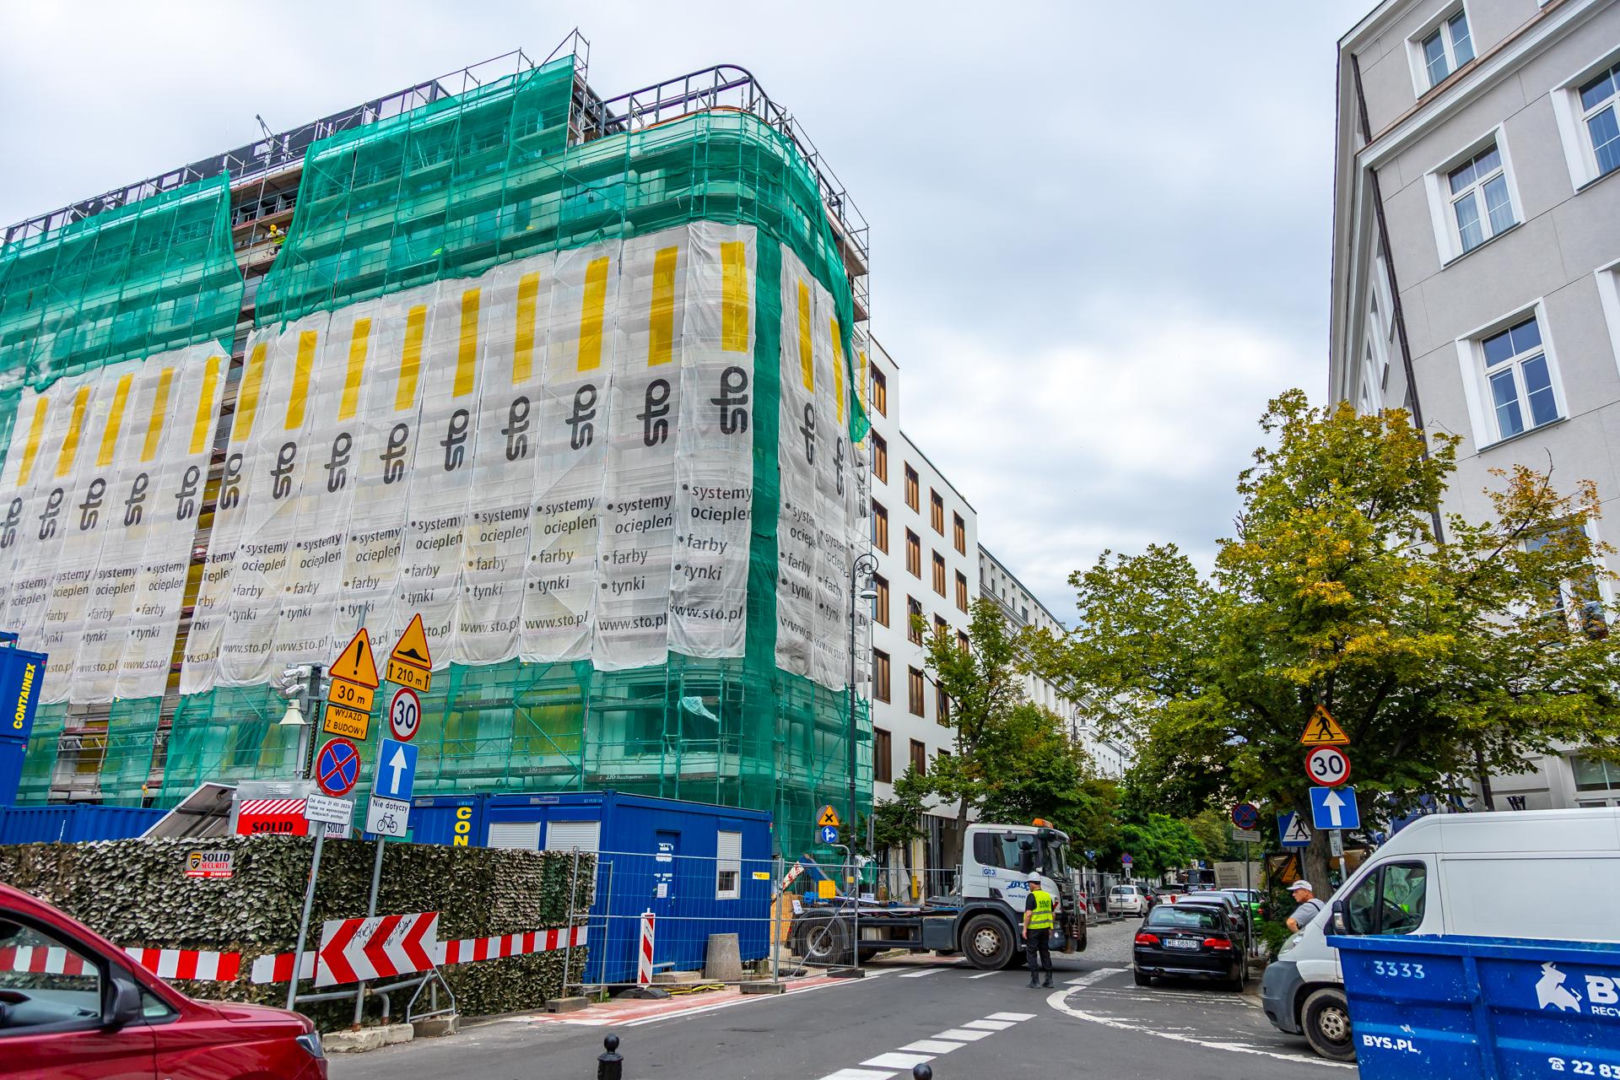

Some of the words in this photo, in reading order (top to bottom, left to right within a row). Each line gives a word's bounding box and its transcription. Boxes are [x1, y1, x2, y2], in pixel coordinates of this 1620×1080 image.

[711, 366, 748, 435] sto
[565, 384, 597, 450] sto
[636, 379, 670, 447] sto
[501, 396, 530, 461] sto
[799, 402, 815, 466] sto
[440, 409, 470, 471] sto
[324, 432, 352, 493] sto
[380, 423, 409, 484] sto
[270, 442, 296, 499] sto
[833, 437, 845, 498] sto
[220, 453, 243, 510] sto
[124, 472, 149, 527] sto
[175, 465, 200, 520] sto
[692, 484, 753, 501] systemy
[79, 478, 106, 530] sto
[545, 496, 595, 517] systemy
[617, 495, 672, 515] systemy
[1, 497, 22, 548] sto
[39, 488, 63, 540] sto
[482, 505, 529, 524] systemy
[615, 513, 673, 534] ociepleń
[418, 516, 462, 533] systemy
[544, 514, 597, 535] ociepleń
[304, 533, 342, 550] systemy
[359, 526, 402, 544] systemy
[416, 531, 463, 551] ociepleń
[687, 533, 728, 555] farby
[246, 540, 289, 556] systemy
[356, 542, 401, 563] ociepleń
[539, 548, 574, 564] farby
[613, 548, 648, 565] farby
[242, 555, 286, 576] ociepleń
[300, 549, 341, 569] ociepleń
[476, 556, 507, 572] farby
[788, 553, 811, 577] farby
[98, 566, 137, 582] systemy
[152, 561, 187, 577] systemy
[411, 564, 440, 579] farby
[684, 565, 723, 582] tynki
[236, 585, 264, 599] farby
[293, 580, 320, 595] farby
[351, 575, 380, 590] farby
[473, 582, 503, 600] tynki
[537, 575, 570, 594] tynki
[611, 576, 645, 595] tynki
[791, 581, 813, 601] tynki
[408, 588, 434, 606] tynki
[141, 604, 166, 618] farby
[232, 607, 257, 621] tynki
[287, 604, 312, 621] tynki
[525, 611, 588, 630] www.sto.pl
[460, 616, 520, 634] www.sto.pl
[598, 612, 668, 631] www.sto.pl
[85, 630, 108, 646] tynki
[136, 625, 161, 641] tynki
[275, 635, 328, 653] www.sto.pl
[397, 667, 414, 683] 210
[415, 677, 422, 687] m
[13, 663, 36, 729] CONTAINEX
[337, 685, 355, 701] 30
[356, 694, 365, 705] m
[334, 708, 363, 722] WYJAZD
[394, 700, 417, 729] 30
[326, 719, 332, 728] Z
[333, 721, 365, 736] BUDOWY
[1313, 755, 1343, 776] 30
[372, 798, 383, 809] Nie
[385, 801, 408, 814] dotyczy
[252, 821, 293, 833] SOLID
[327, 823, 345, 834] SOLID
[201, 862, 229, 870] SECURITY
[202, 853, 230, 863] SOLID
[1373, 960, 1425, 979] 3333
[1584, 974, 1620, 1005] B
[1363, 1034, 1419, 1053] BYS.PL
[1571, 1059, 1595, 1076] 22
[1599, 1064, 1620, 1080] 83
